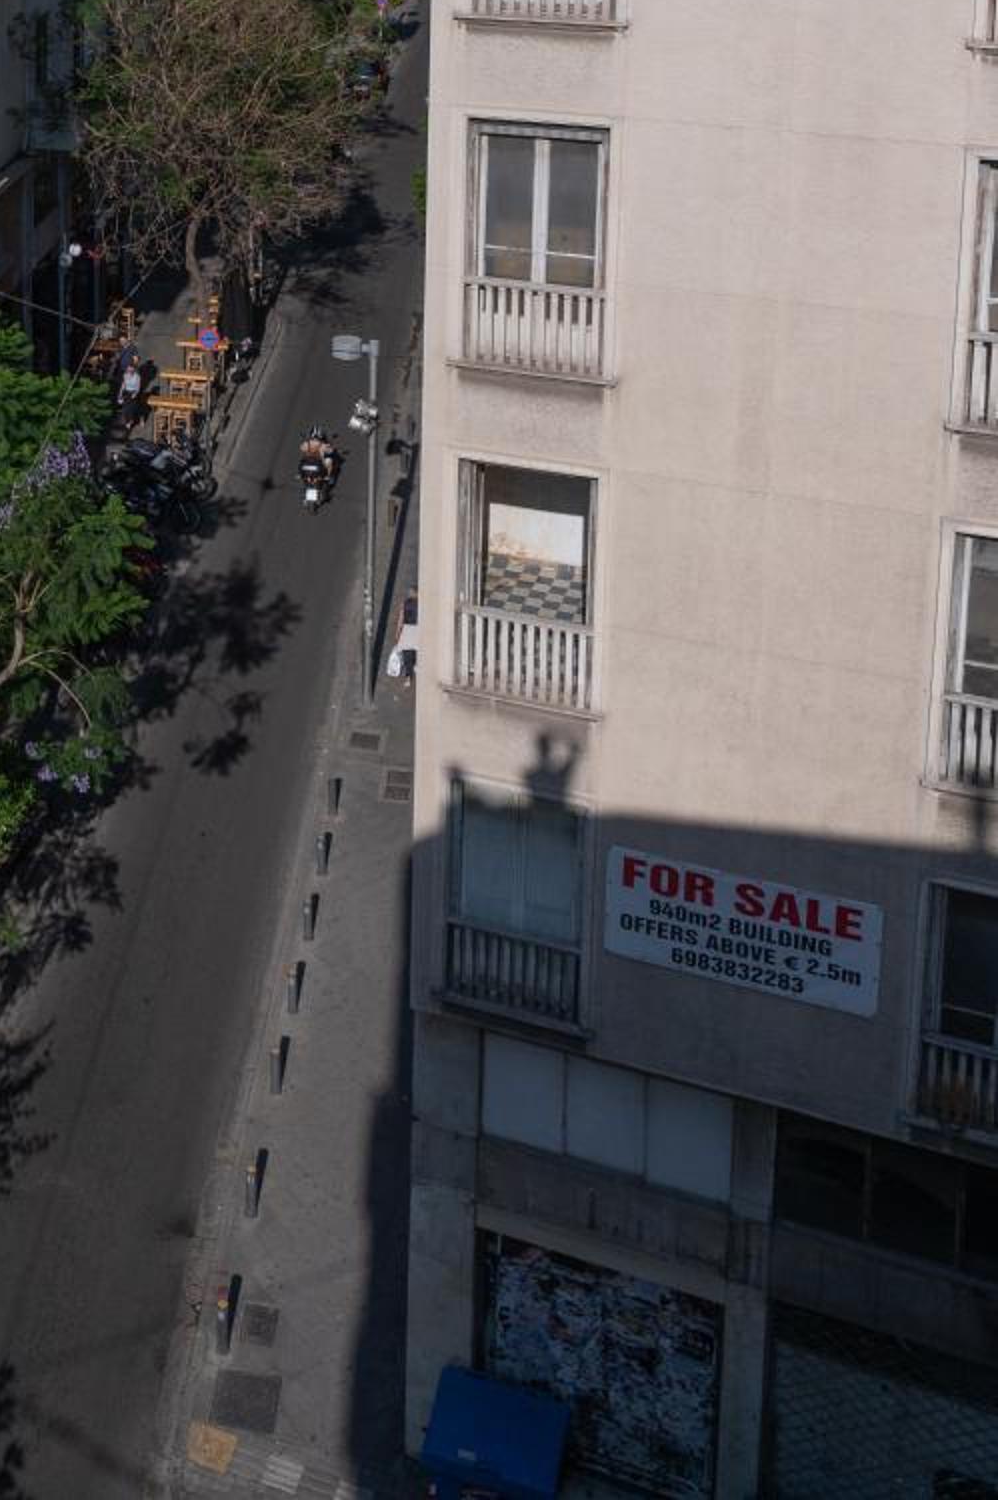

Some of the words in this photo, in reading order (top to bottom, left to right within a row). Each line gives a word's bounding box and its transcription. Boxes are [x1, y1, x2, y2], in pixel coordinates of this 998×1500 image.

[622, 855, 714, 907] FOR
[734, 882, 864, 942] SALE
[620, 913, 698, 947] OFFERS
[706, 936, 776, 966] ABOVE
[729, 917, 833, 957] BUILDING
